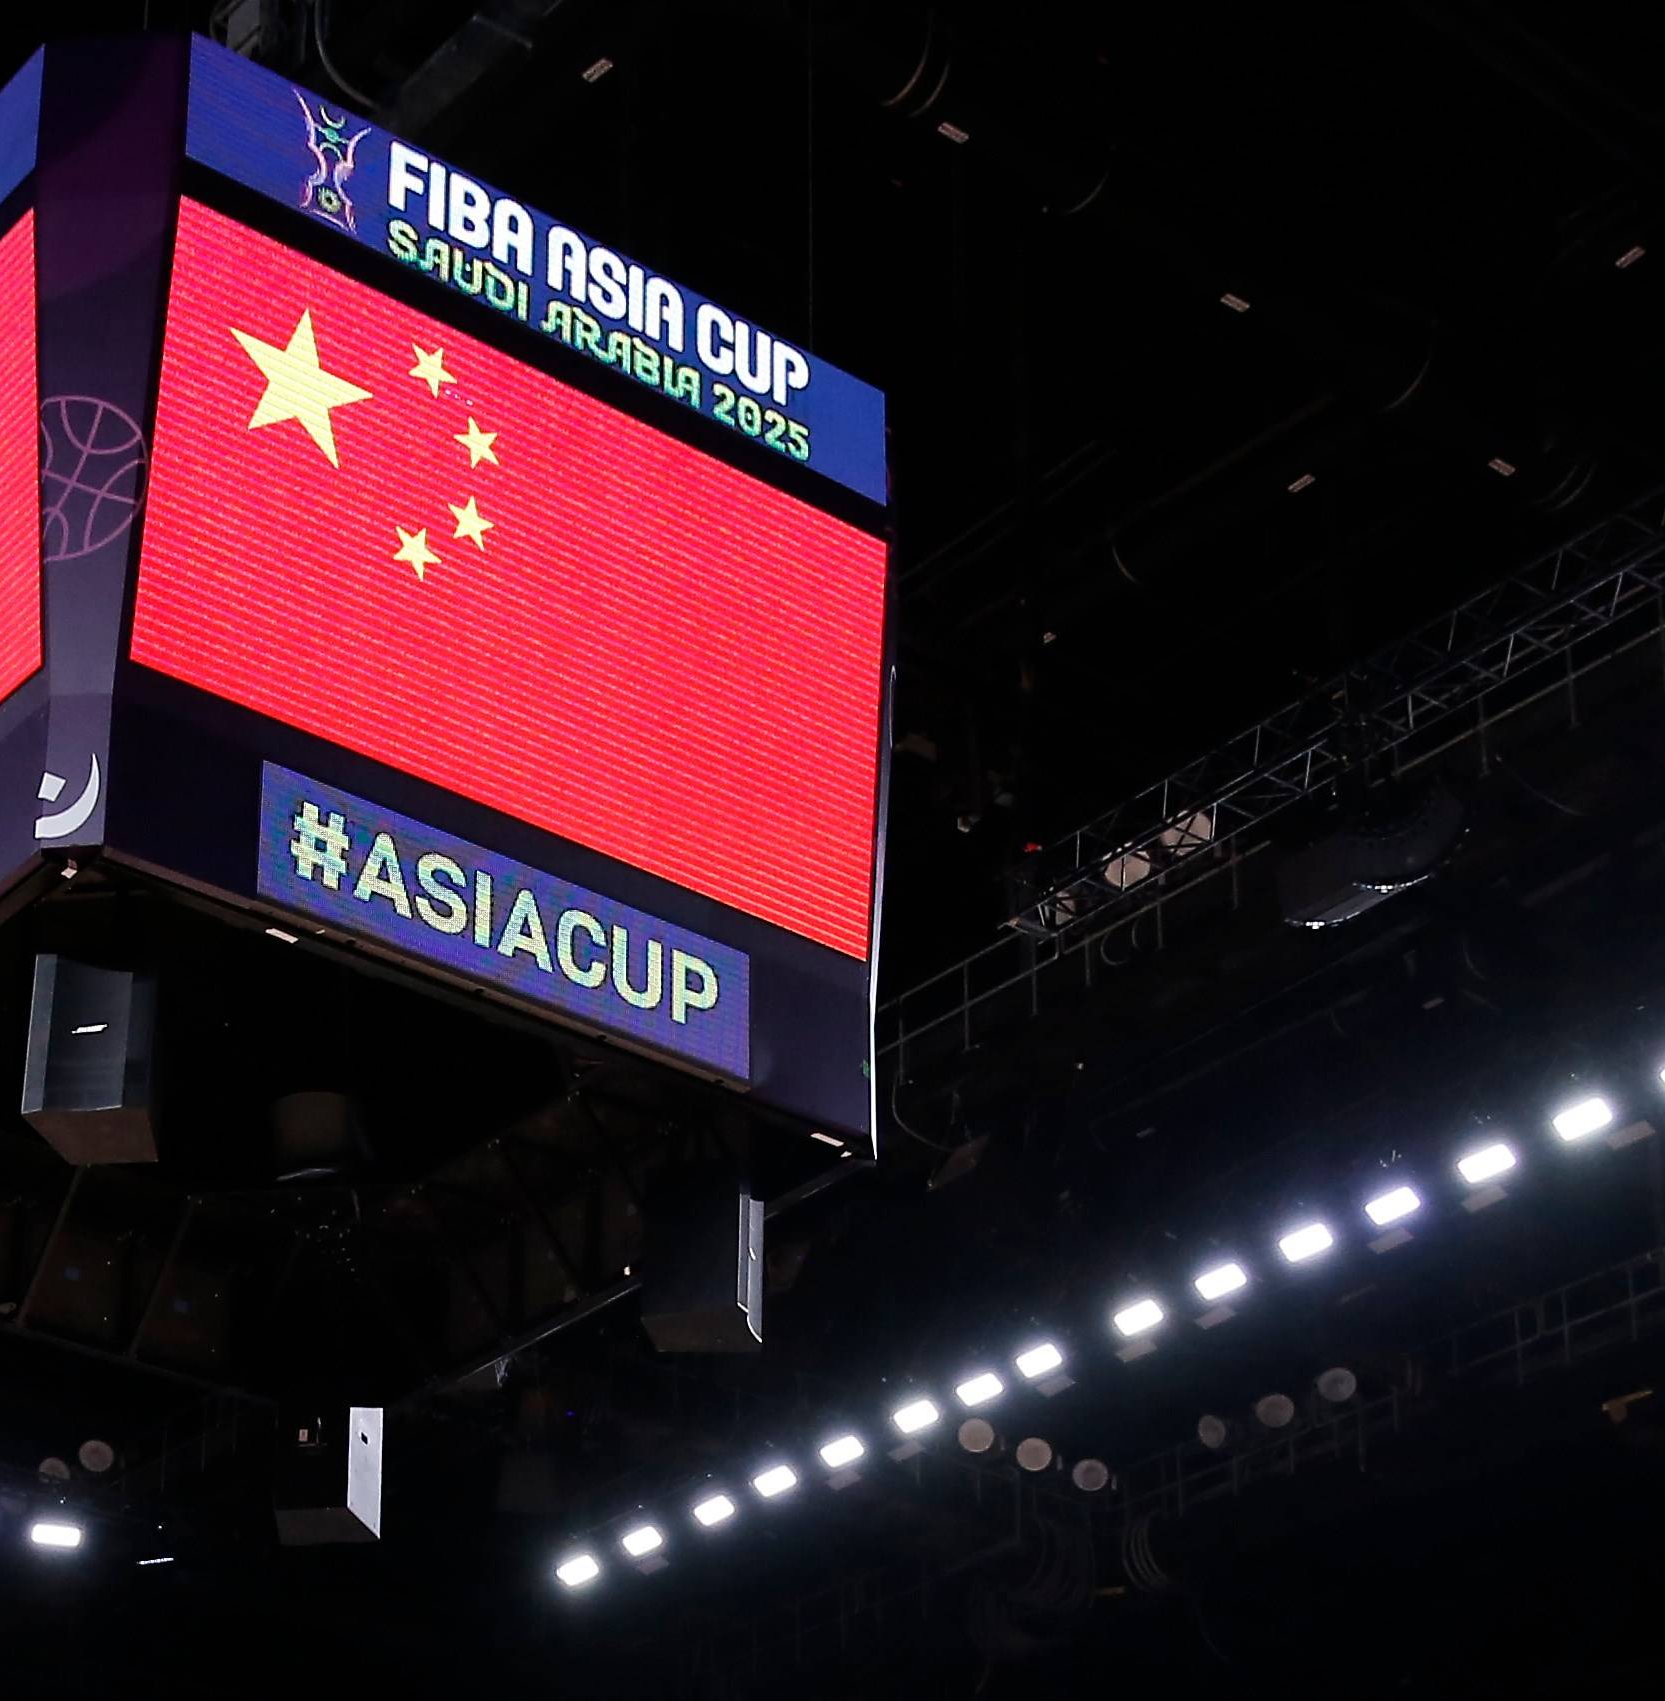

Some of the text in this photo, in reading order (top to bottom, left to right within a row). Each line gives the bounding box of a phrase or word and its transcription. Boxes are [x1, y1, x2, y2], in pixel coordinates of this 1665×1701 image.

[387, 139, 810, 406] FIBA ASIA CUP
[387, 220, 811, 462] SAUDI ARABIA 2025
[290, 800, 720, 1025] #ASIACUP
